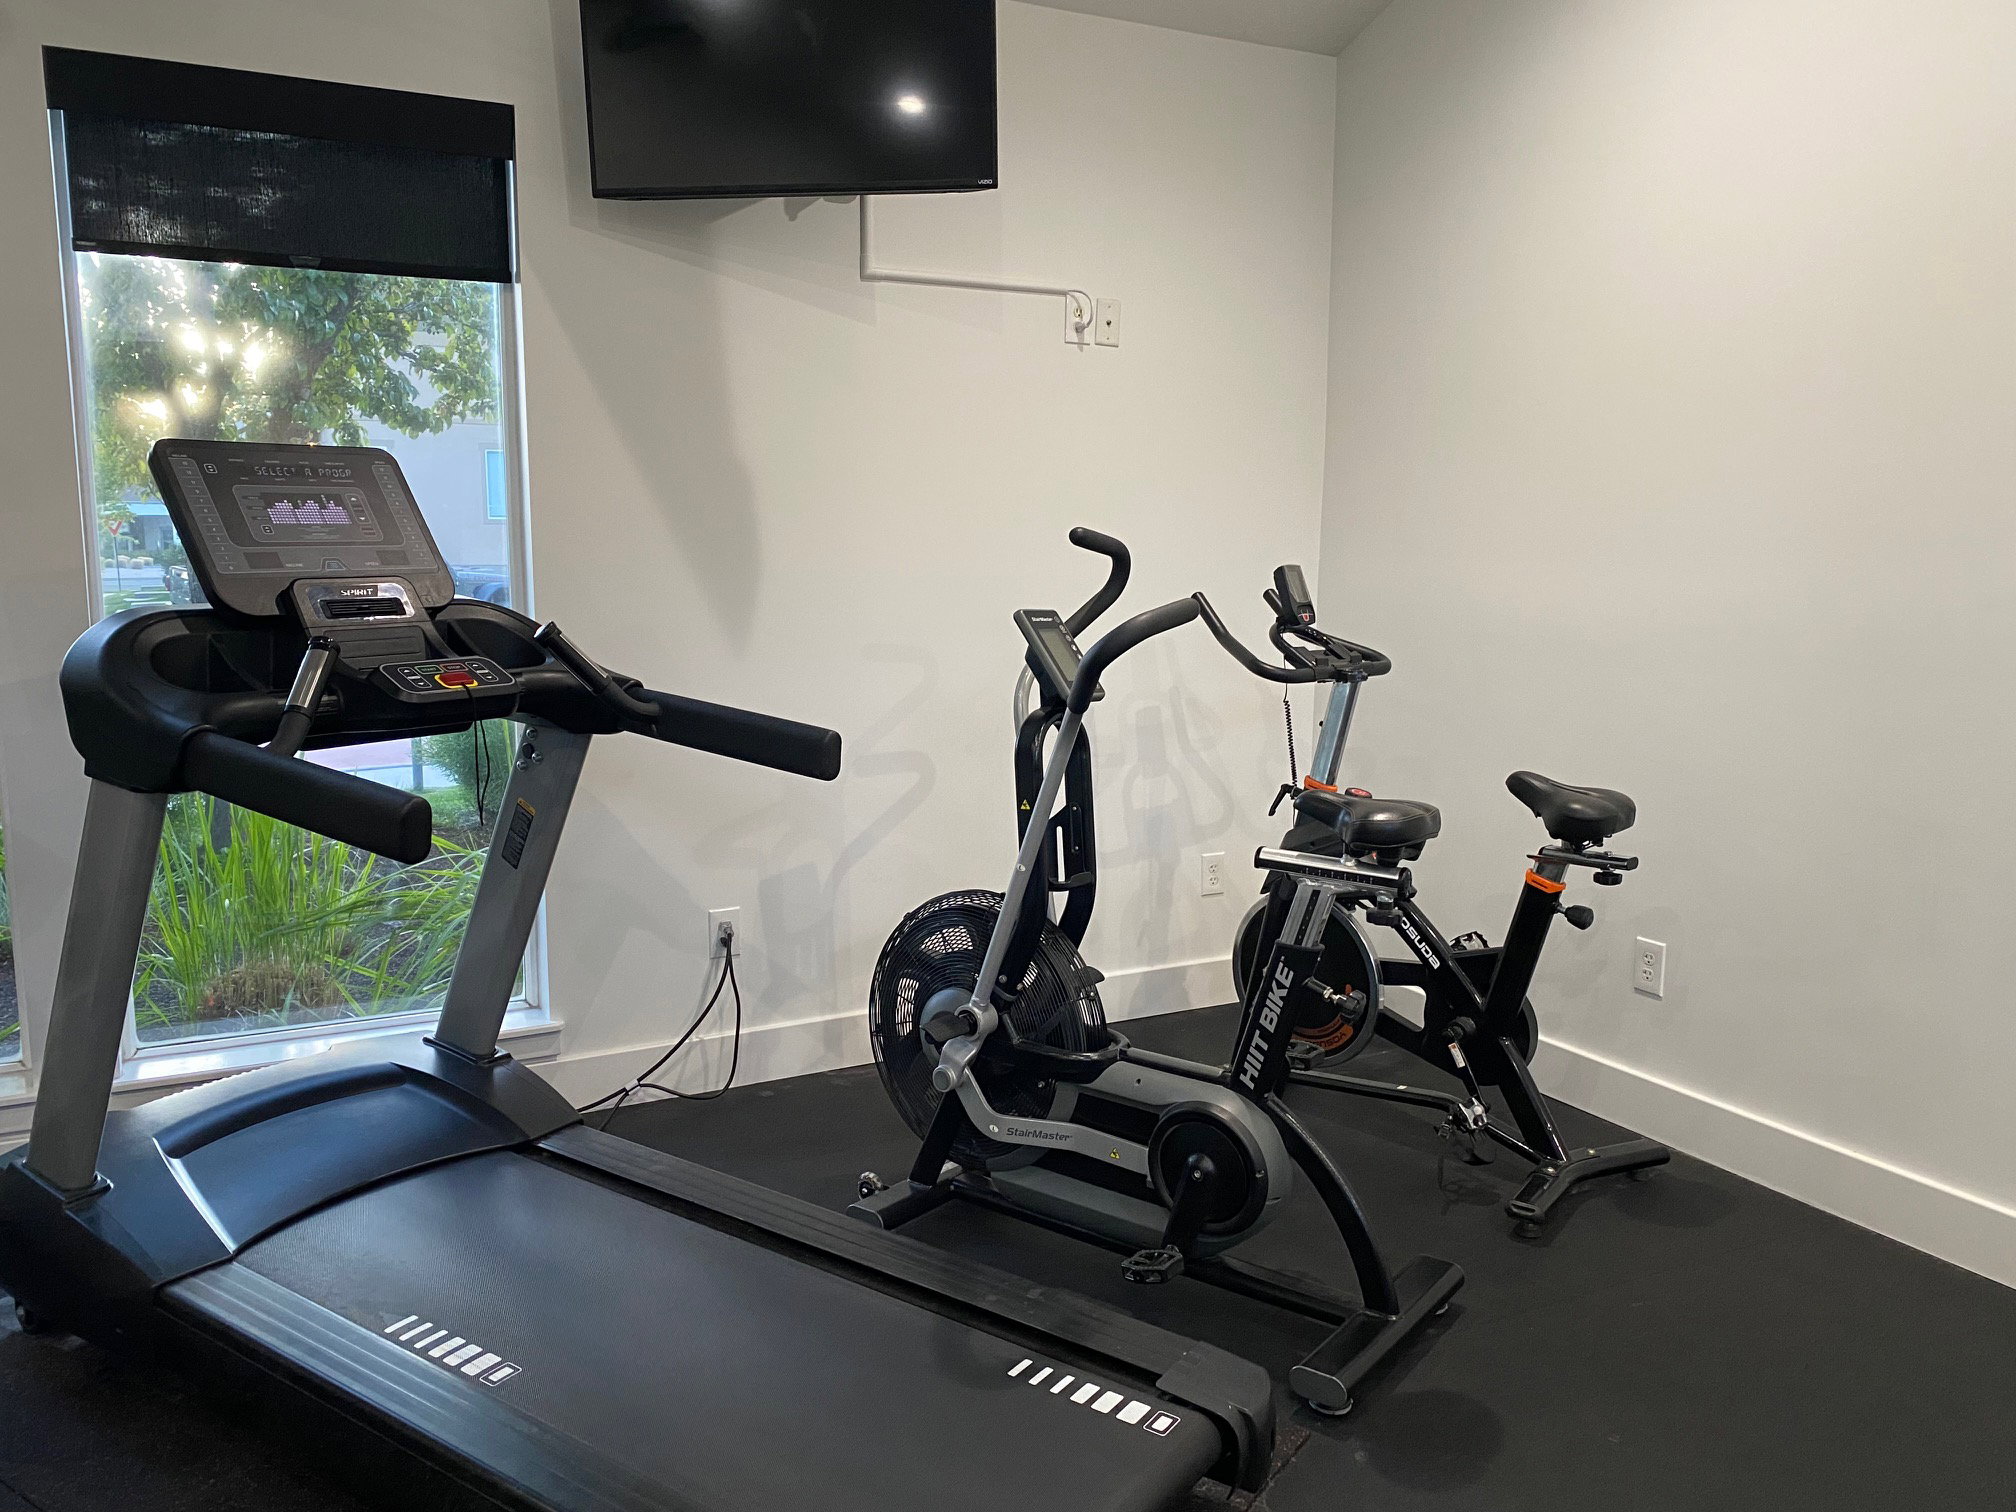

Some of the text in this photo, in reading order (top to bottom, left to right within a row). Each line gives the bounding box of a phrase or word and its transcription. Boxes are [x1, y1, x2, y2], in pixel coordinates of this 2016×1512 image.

[304, 468, 312, 477] A
[340, 588, 374, 596] SPIRIT
[1400, 916, 1441, 970] OSUDA
[1239, 960, 1294, 1091] HIIT BIKE
[1006, 1127, 1070, 1141] StairMaster
